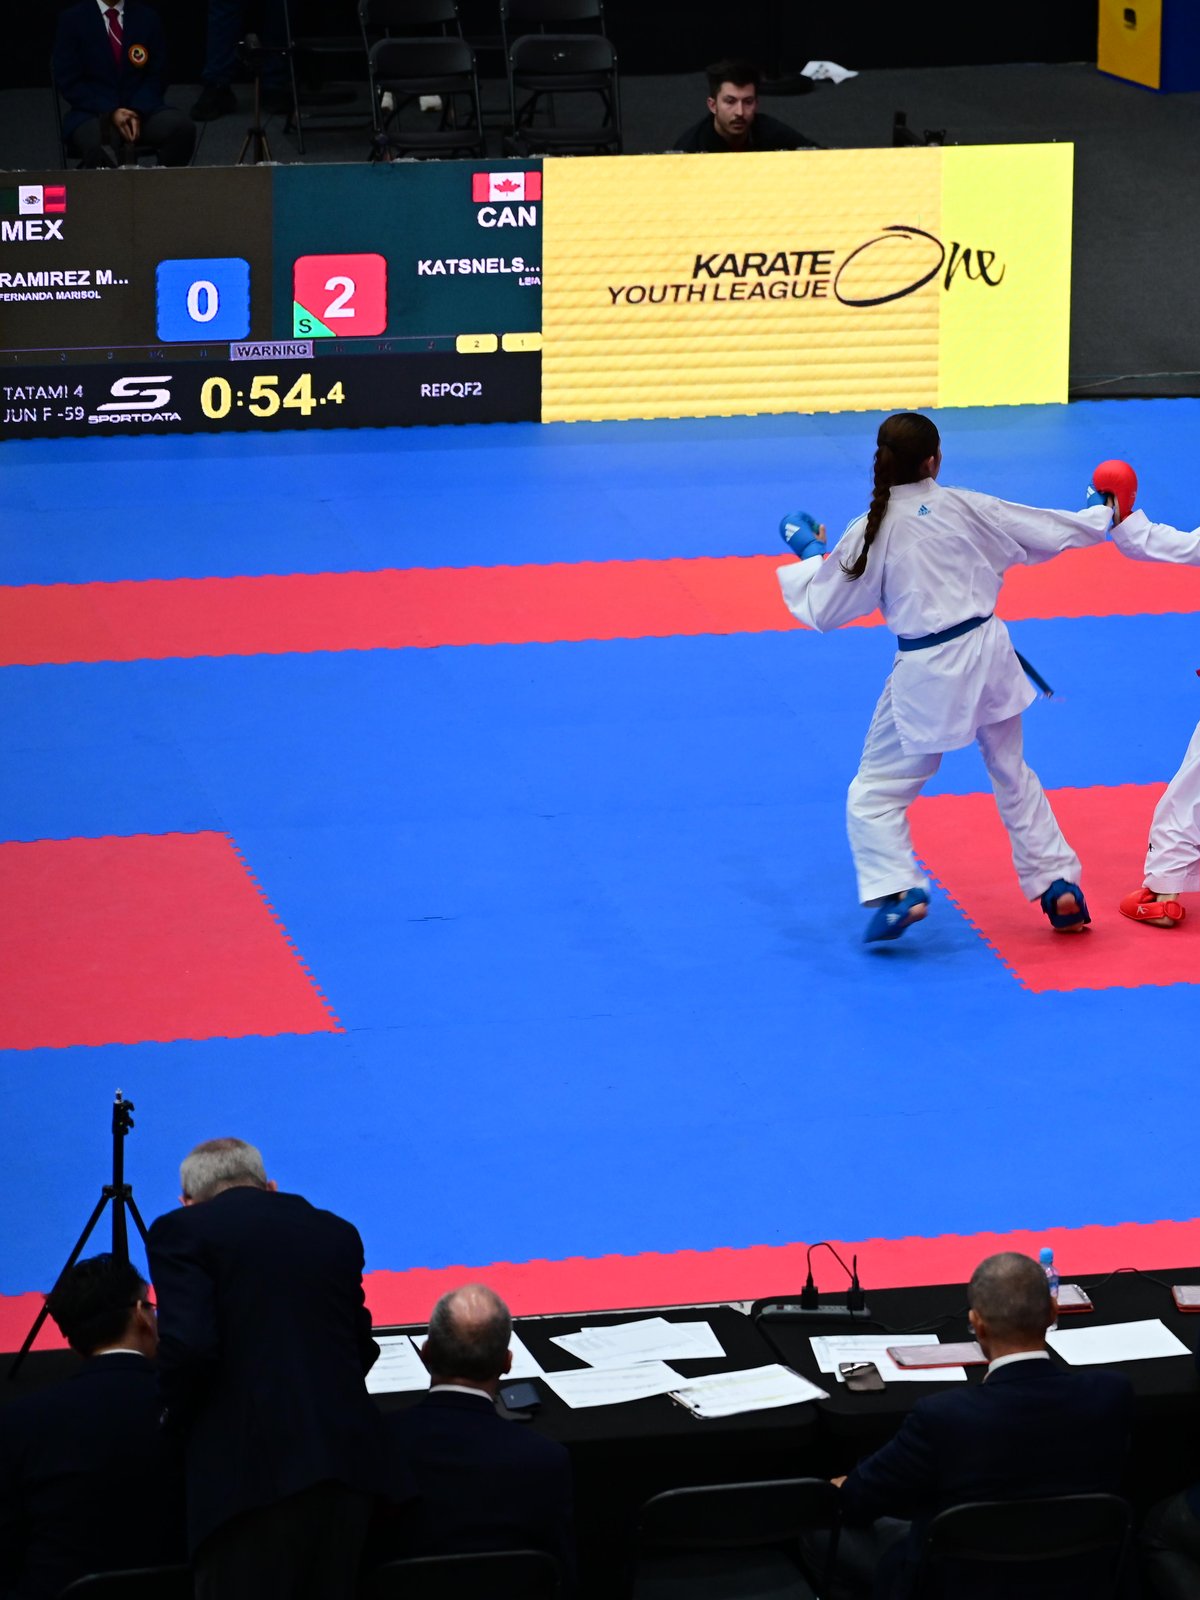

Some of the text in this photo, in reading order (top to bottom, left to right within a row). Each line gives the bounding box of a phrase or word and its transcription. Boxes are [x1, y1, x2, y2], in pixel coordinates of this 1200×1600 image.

[477, 205, 537, 228] CAN
[1, 219, 64, 242] MEX
[692, 225, 1006, 308] KARATE One
[0, 270, 90, 288] RAMIREZ
[0, 290, 101, 303] FERNANDA MARISOL
[187, 280, 218, 322] 0
[324, 276, 355, 318] 2
[608, 280, 829, 305] YOUTH LEAGUE
[299, 319, 312, 334] S
[237, 344, 308, 358] WARNING
[3, 384, 84, 401] TATAMI 4
[420, 381, 483, 398] REPQF2
[3, 406, 85, 423] JUN F -59
[88, 411, 182, 425] SPORTDATA
